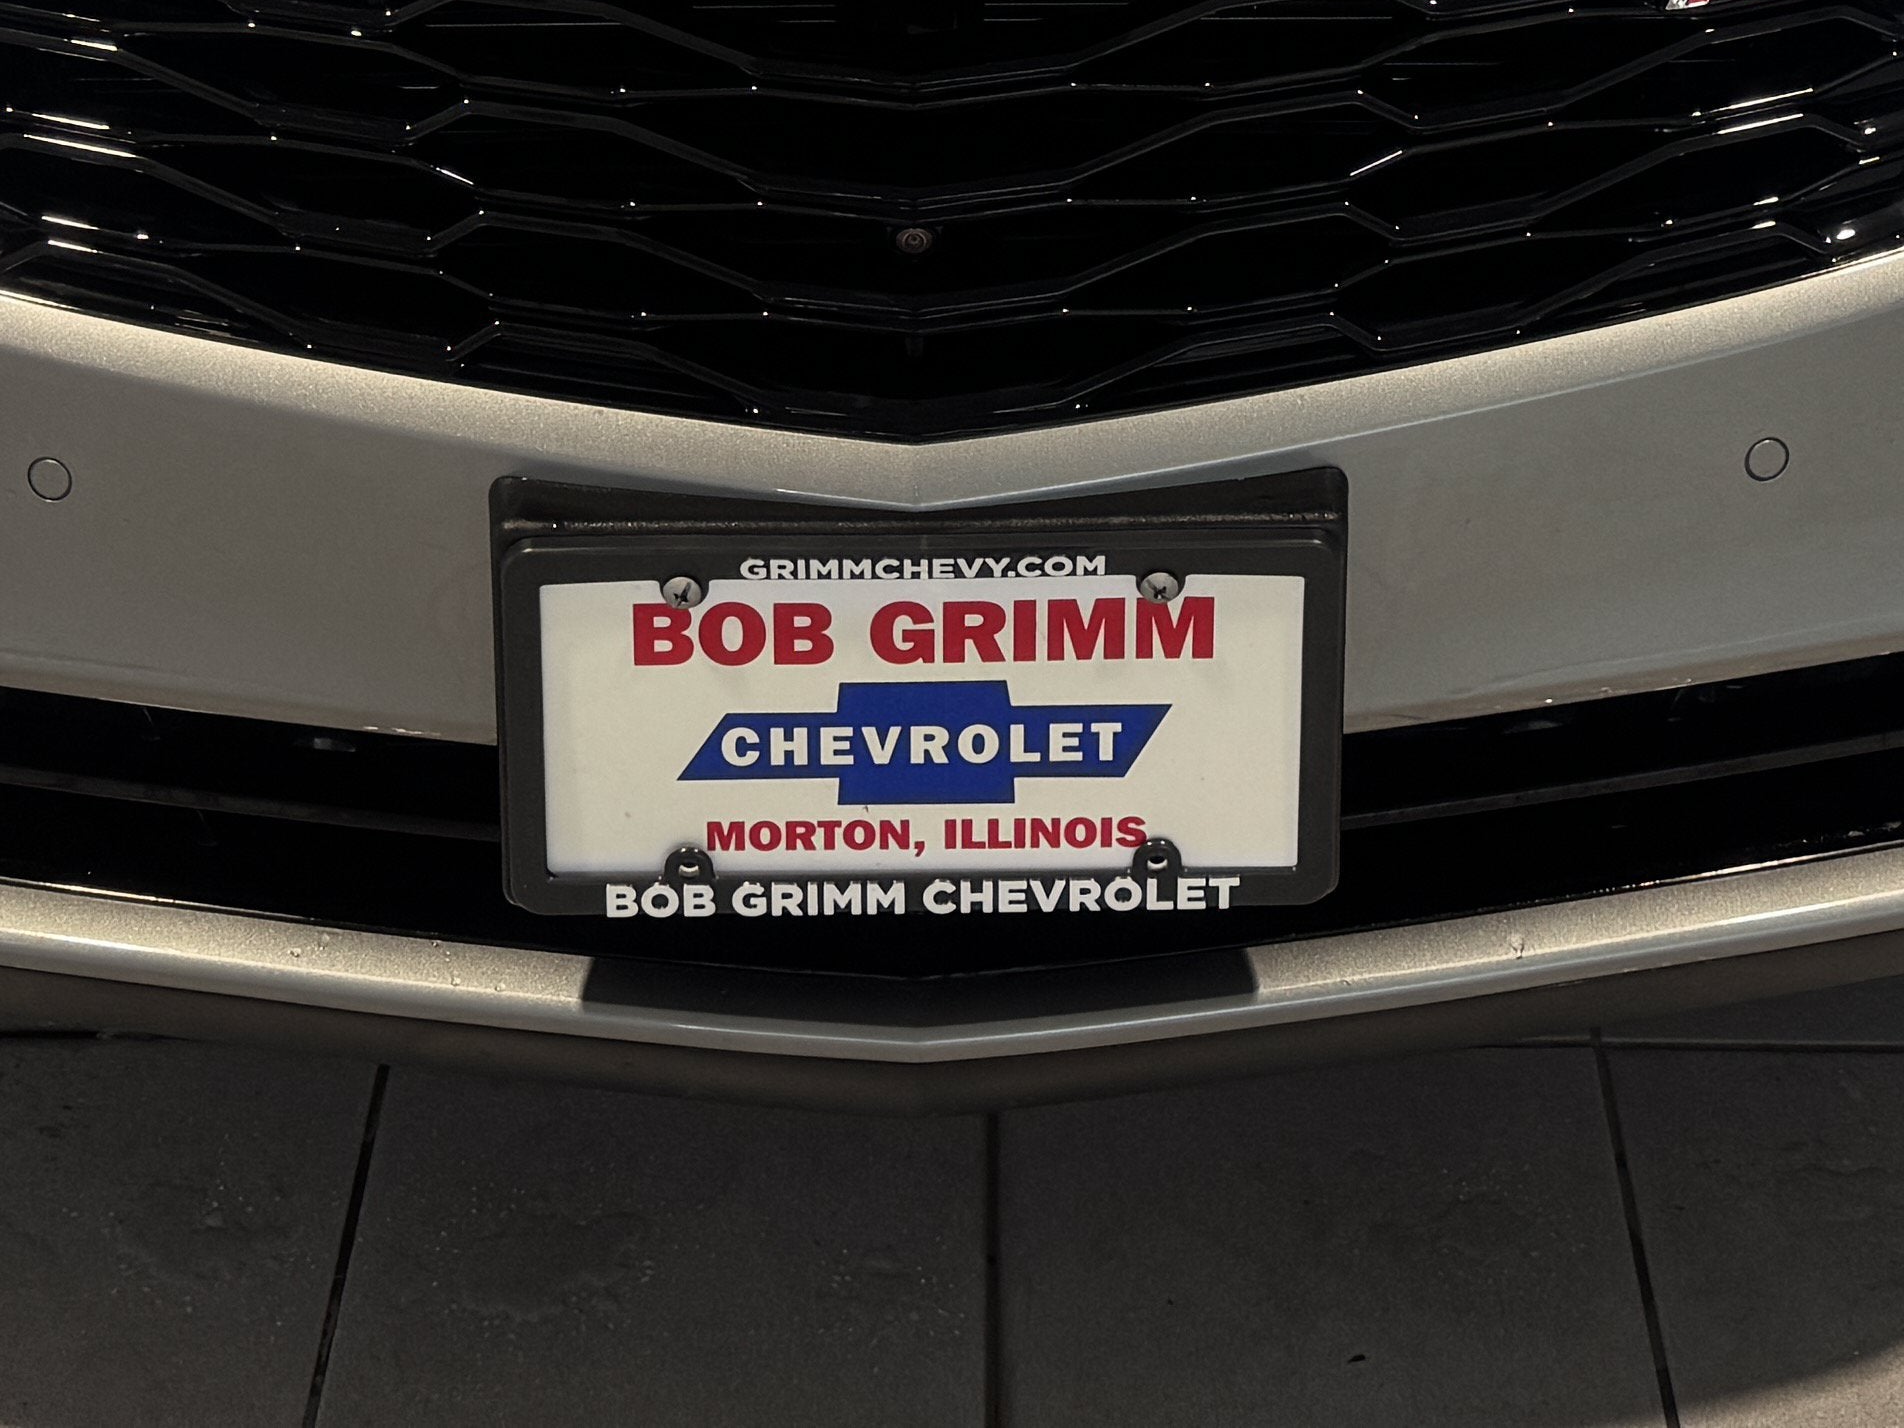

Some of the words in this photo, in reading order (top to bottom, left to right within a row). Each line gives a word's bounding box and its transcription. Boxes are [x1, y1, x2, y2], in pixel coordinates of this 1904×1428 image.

[739, 555, 1107, 581] GRIMMCHEVY.COM
[632, 602, 835, 667] BOB
[870, 596, 1216, 665] GRIMM
[720, 722, 1123, 767] CHEVROLET
[706, 819, 926, 857] MORTON,
[944, 816, 1149, 850] ILLINOIS
[605, 882, 716, 918] BOB
[731, 879, 907, 917] GRIMM
[922, 875, 1241, 914] CHEVROLET
